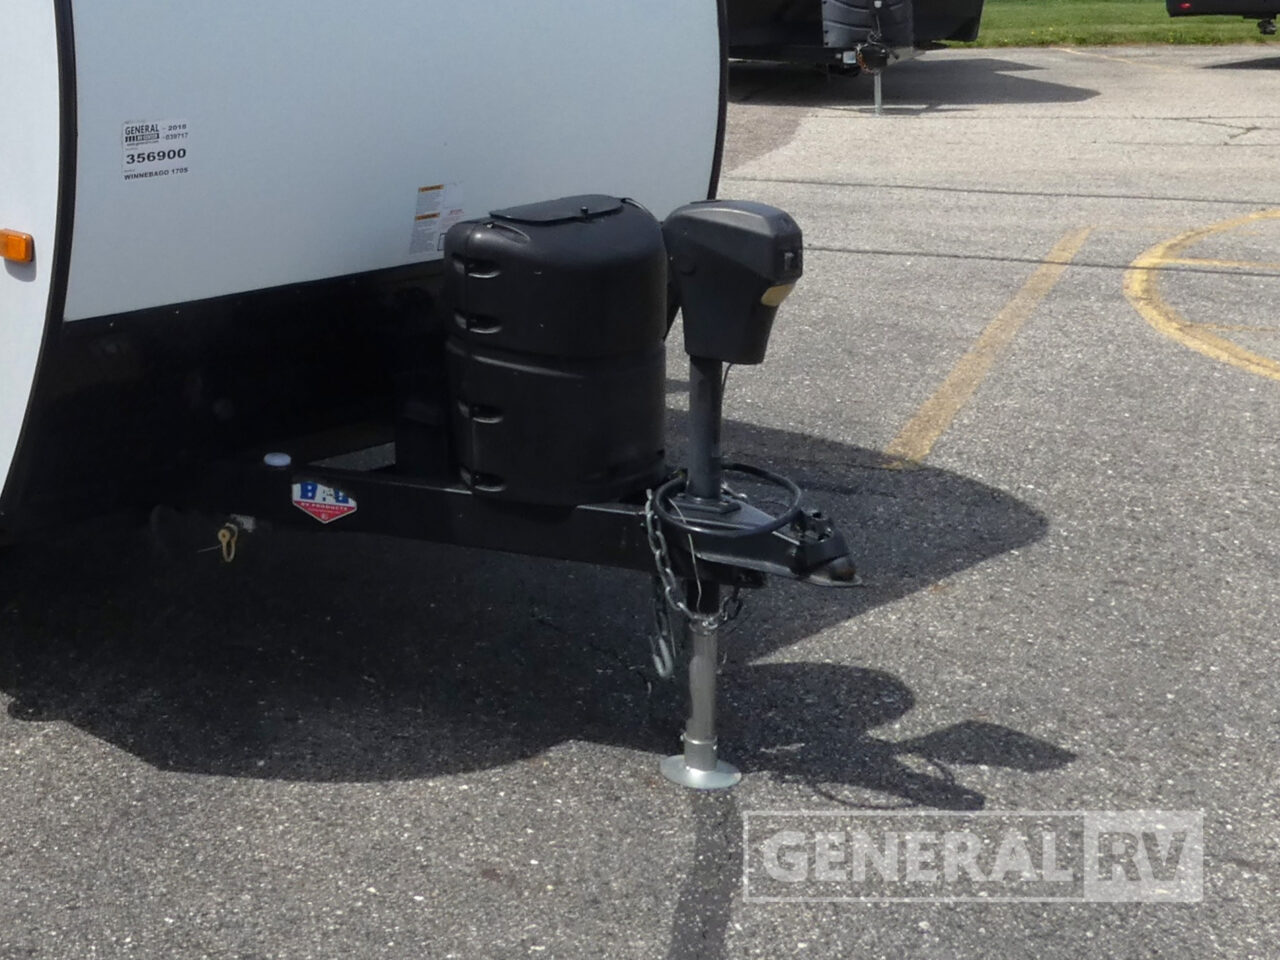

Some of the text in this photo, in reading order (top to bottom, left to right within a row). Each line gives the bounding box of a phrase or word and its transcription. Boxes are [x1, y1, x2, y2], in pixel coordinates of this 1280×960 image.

[125, 124, 159, 135] GENERAL
[126, 148, 186, 164] 356900
[124, 170, 169, 180] WINNEBAGO
